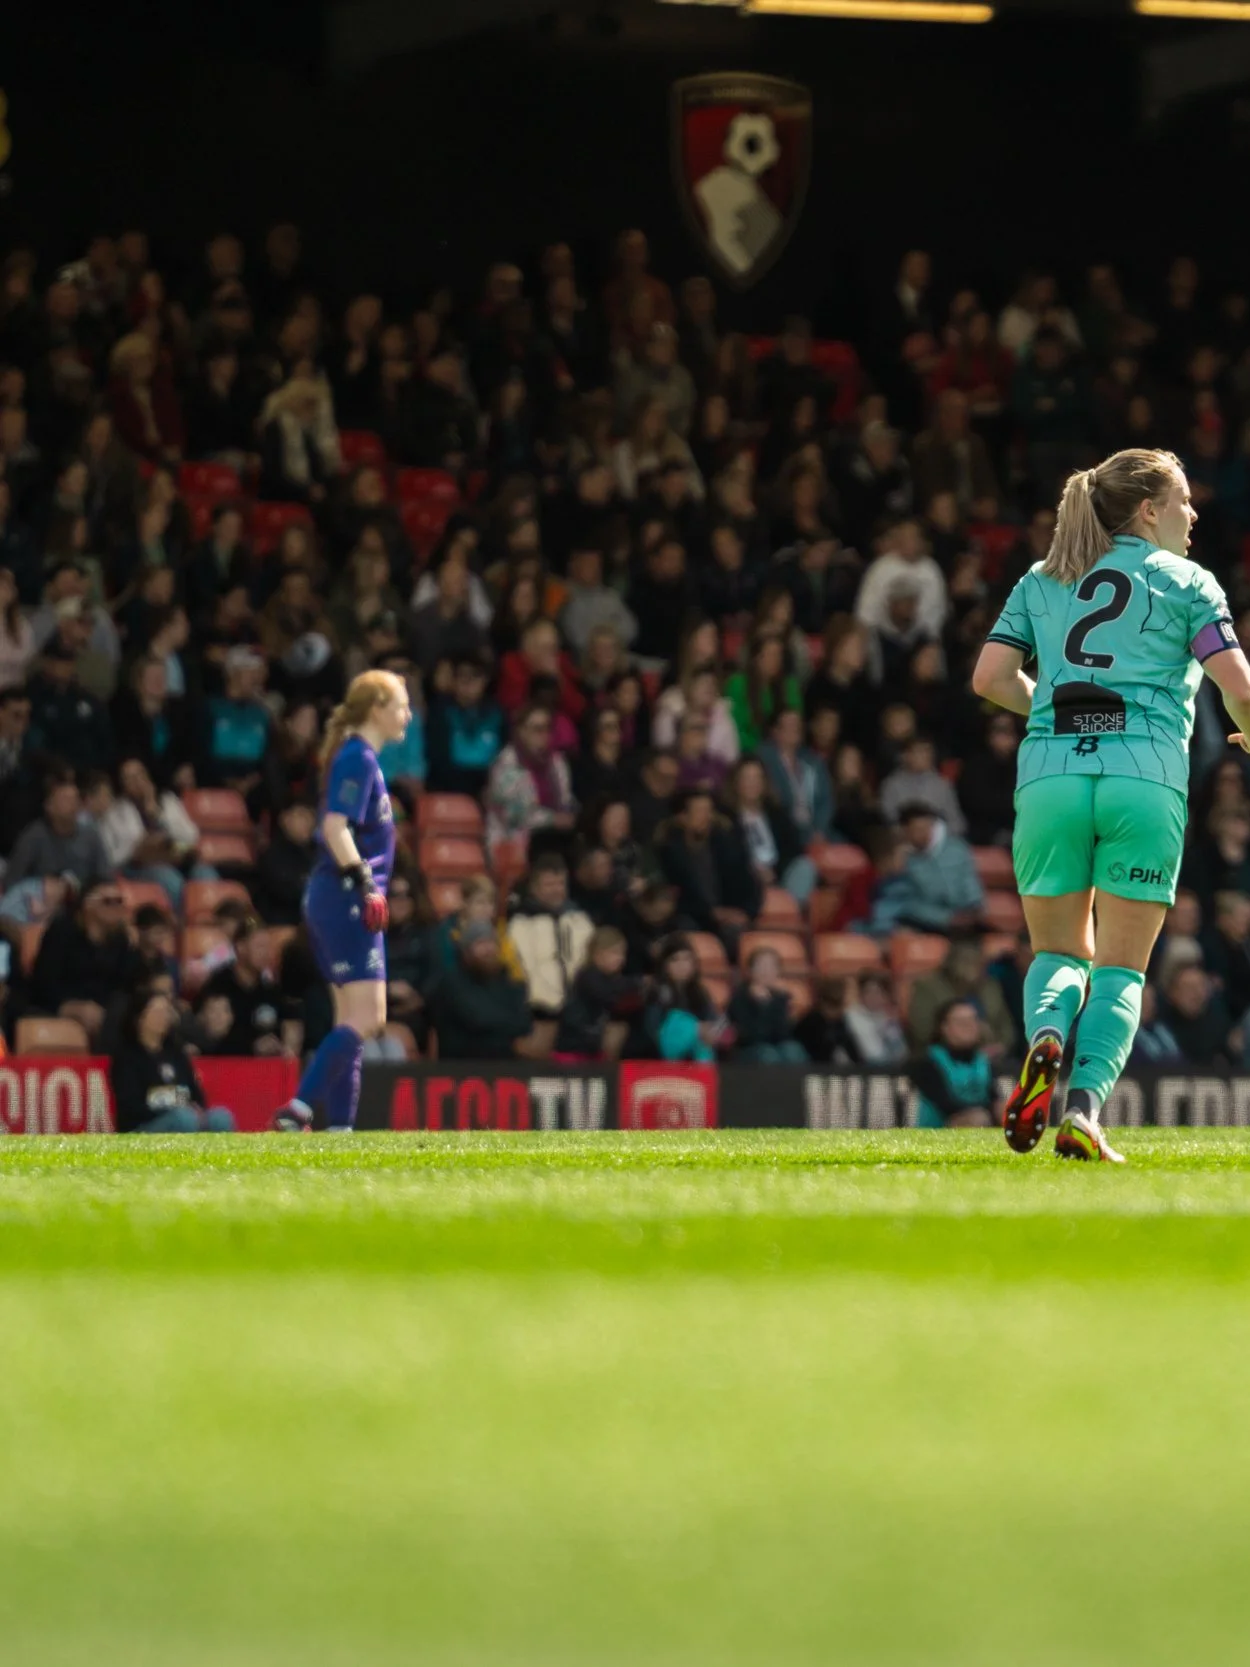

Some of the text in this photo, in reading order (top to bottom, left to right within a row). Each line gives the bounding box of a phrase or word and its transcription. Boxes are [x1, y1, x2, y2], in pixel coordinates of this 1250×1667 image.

[1063, 567, 1133, 670] 2
[1073, 711, 1125, 726] STONE
[1081, 722, 1125, 734] RIDGE
